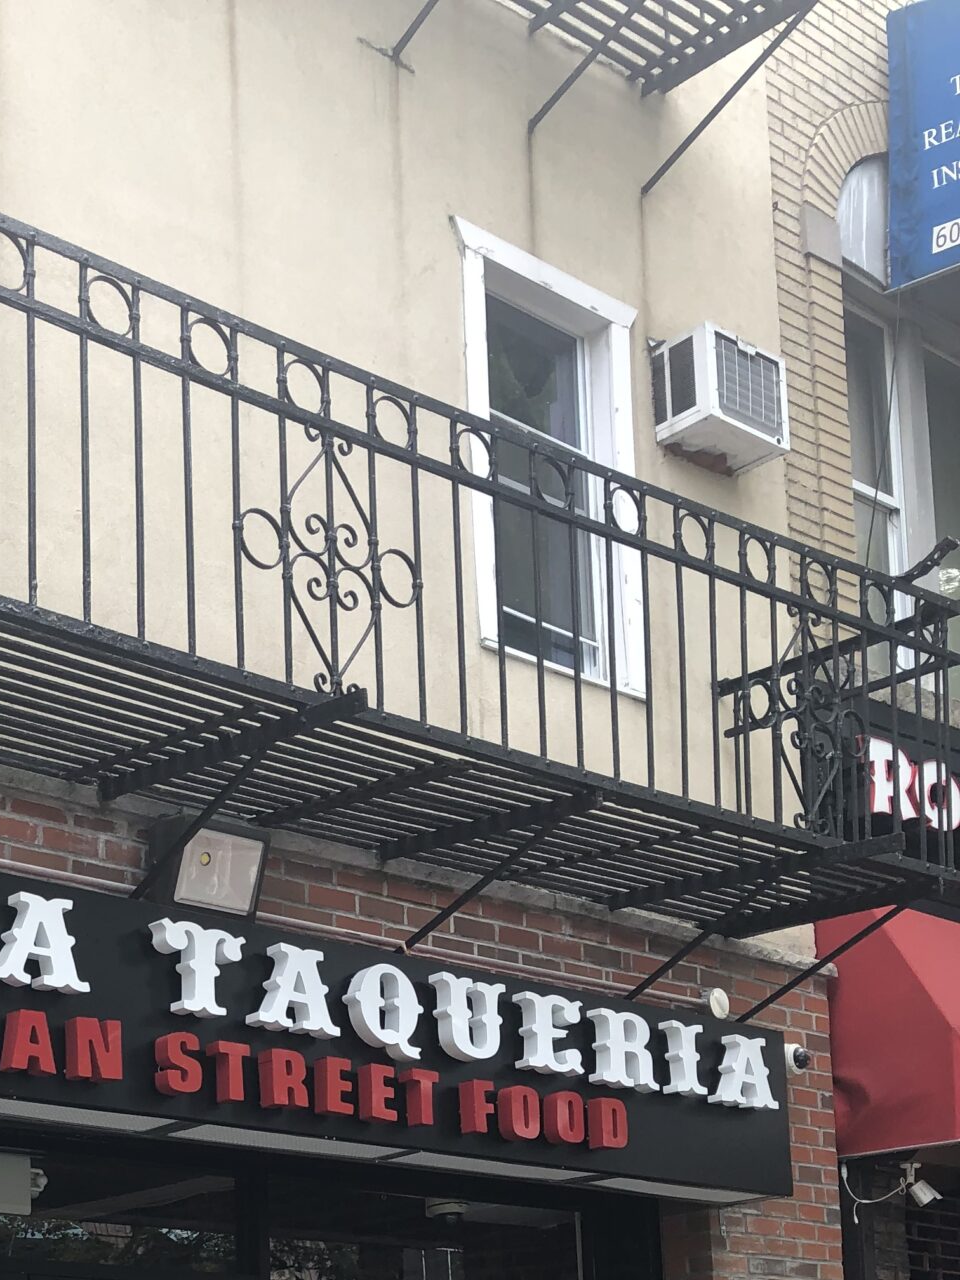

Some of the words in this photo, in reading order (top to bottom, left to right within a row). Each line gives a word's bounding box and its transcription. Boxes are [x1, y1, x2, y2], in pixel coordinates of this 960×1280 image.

[148, 917, 780, 1111] TAQUERIA
[155, 1031, 439, 1128] STREET
[459, 1079, 629, 1151] FOOD
